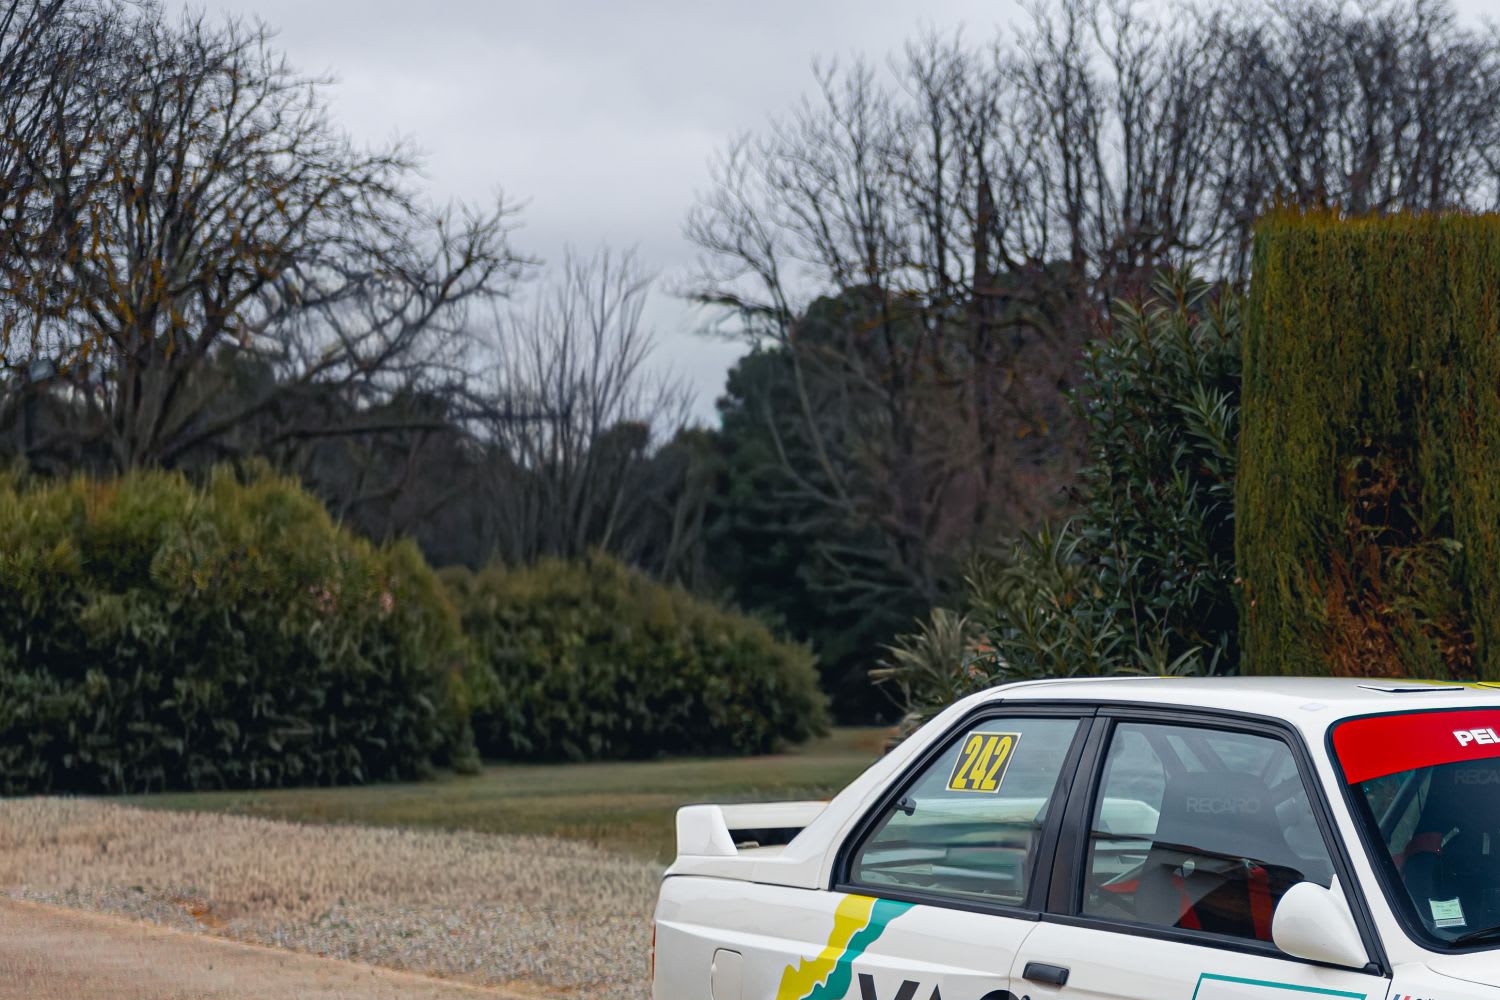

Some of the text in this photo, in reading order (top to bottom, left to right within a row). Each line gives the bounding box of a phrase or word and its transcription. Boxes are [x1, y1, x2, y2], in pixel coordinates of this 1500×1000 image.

[951, 735, 1012, 790] 242
[1454, 768, 1500, 785] RECA
[1186, 797, 1259, 814] RECARO
